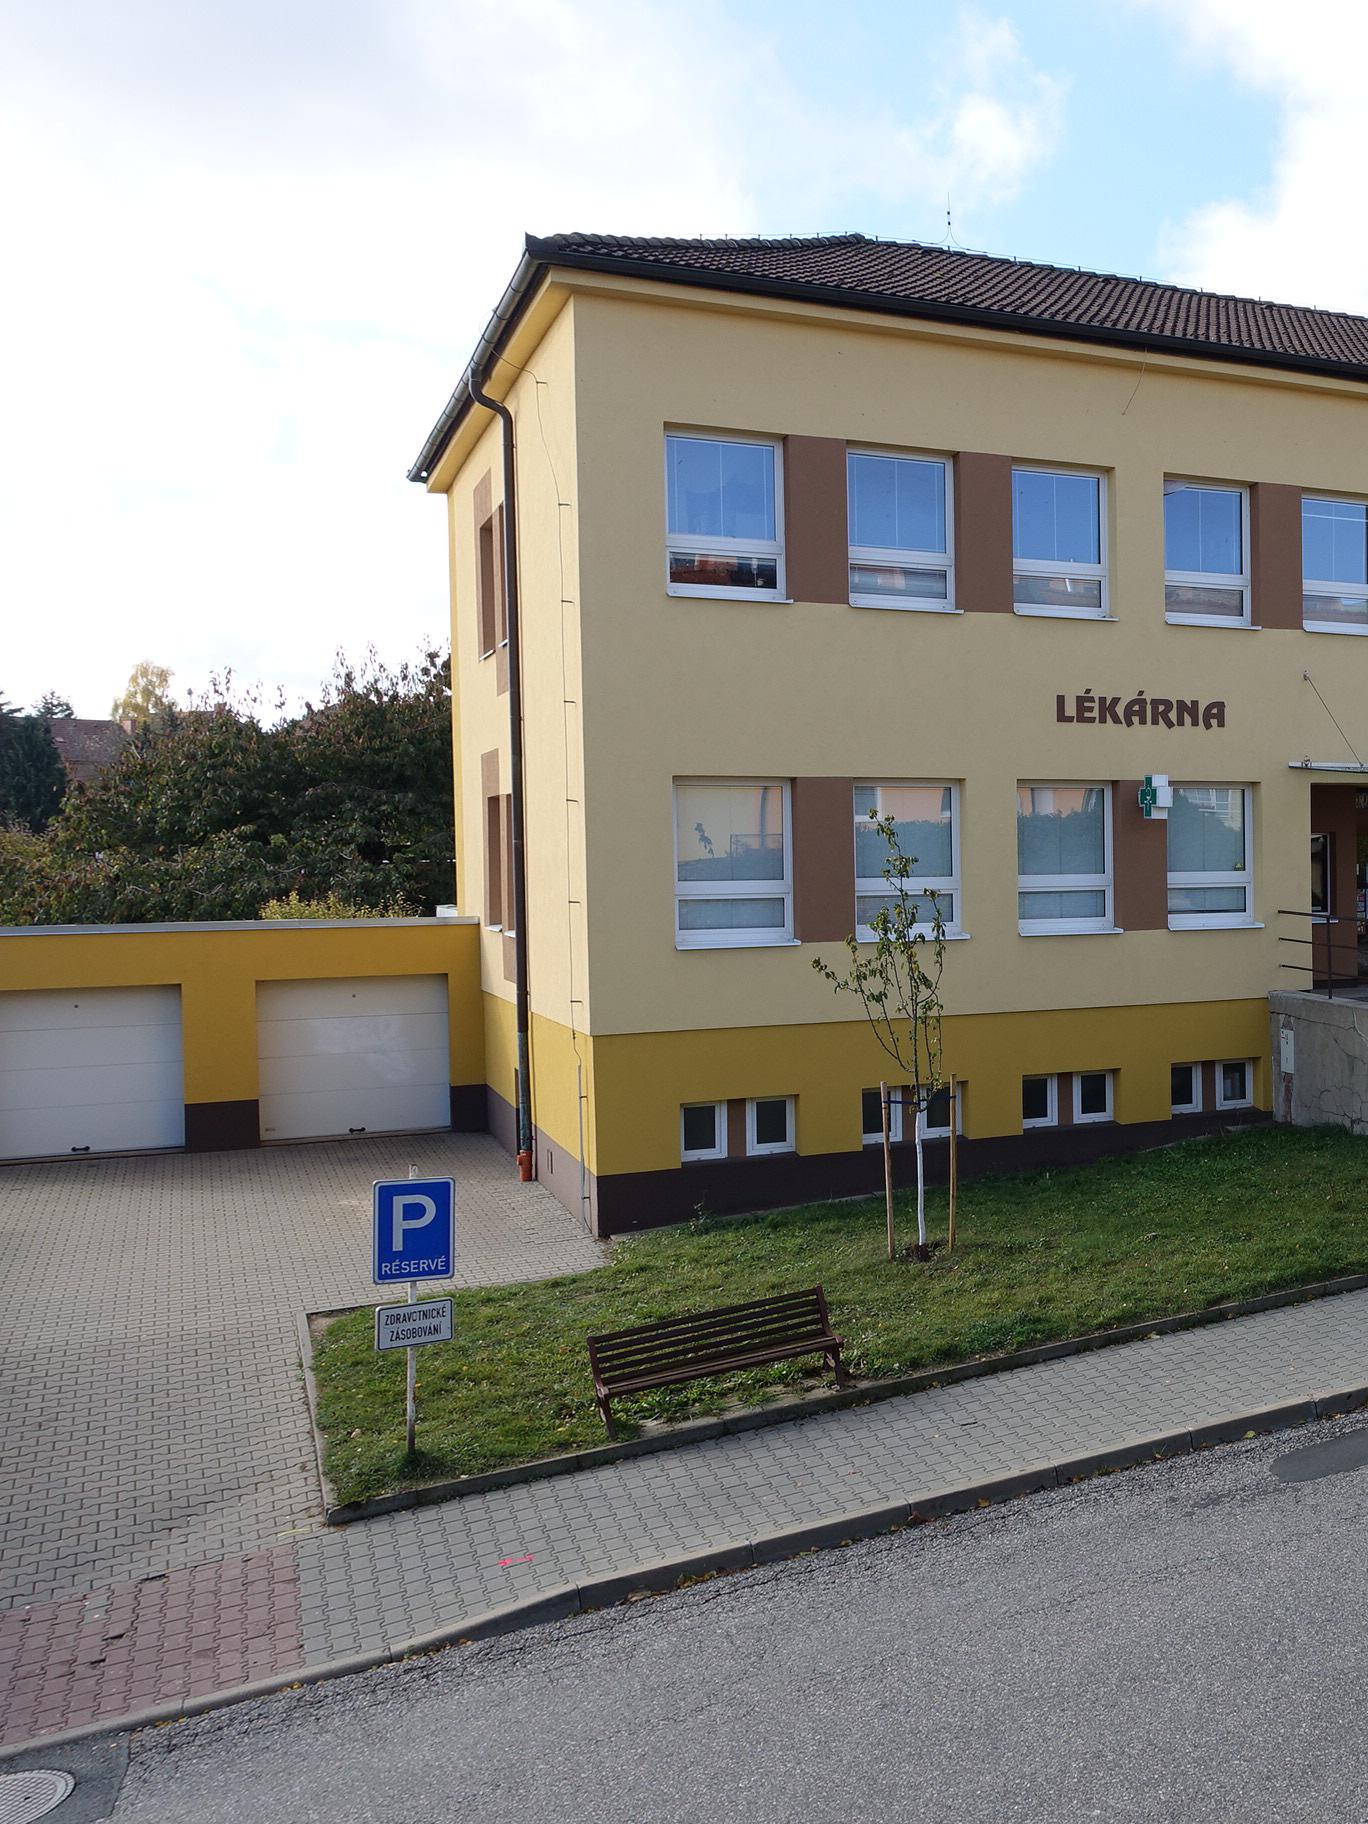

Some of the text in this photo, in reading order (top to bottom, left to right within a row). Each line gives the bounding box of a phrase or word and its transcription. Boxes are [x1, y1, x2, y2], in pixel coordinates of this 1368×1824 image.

[1056, 688, 1226, 731] LÉKÁRNA
[392, 1194, 437, 1252] P
[382, 1256, 446, 1275] RÉSERVÉ
[384, 1304, 447, 1326] ZDRAVOTNICKÉ
[389, 1321, 442, 1342] ZÁSOBOVÁNÍ
